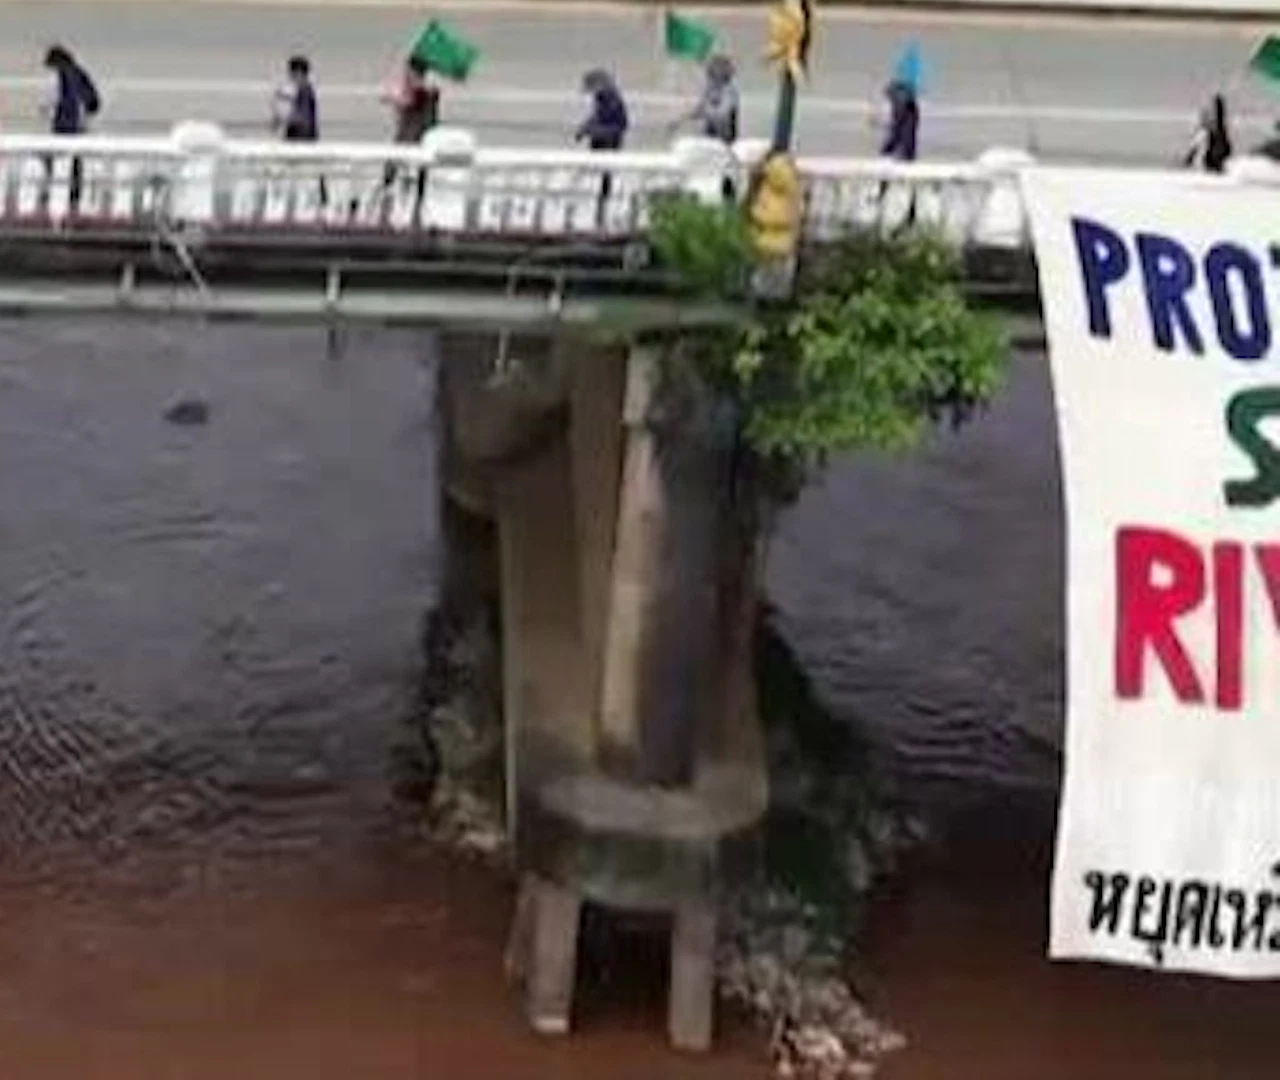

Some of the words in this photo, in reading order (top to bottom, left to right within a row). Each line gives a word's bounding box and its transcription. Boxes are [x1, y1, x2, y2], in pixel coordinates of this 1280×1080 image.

[1070, 216, 1280, 360] PRO
[1085, 862, 1280, 964] หยุดเห
